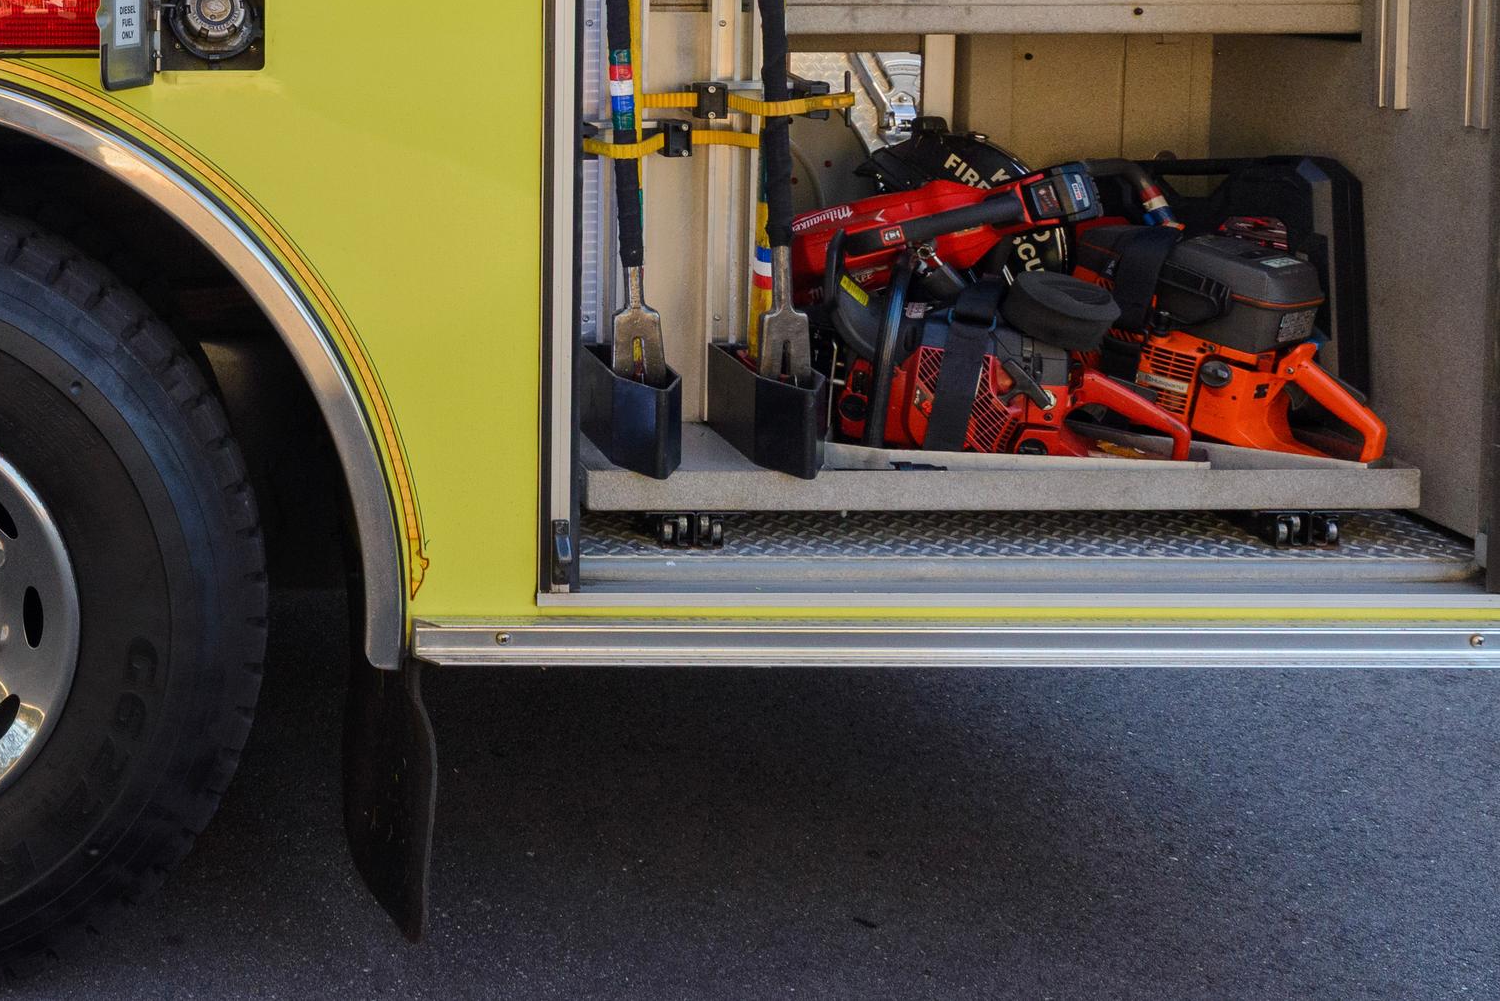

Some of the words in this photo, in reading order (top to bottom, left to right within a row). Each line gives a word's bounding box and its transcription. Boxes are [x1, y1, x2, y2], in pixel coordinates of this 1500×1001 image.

[119, 5, 136, 15] DIESEL
[121, 18, 134, 28] FUEL
[121, 30, 134, 40] ONLY
